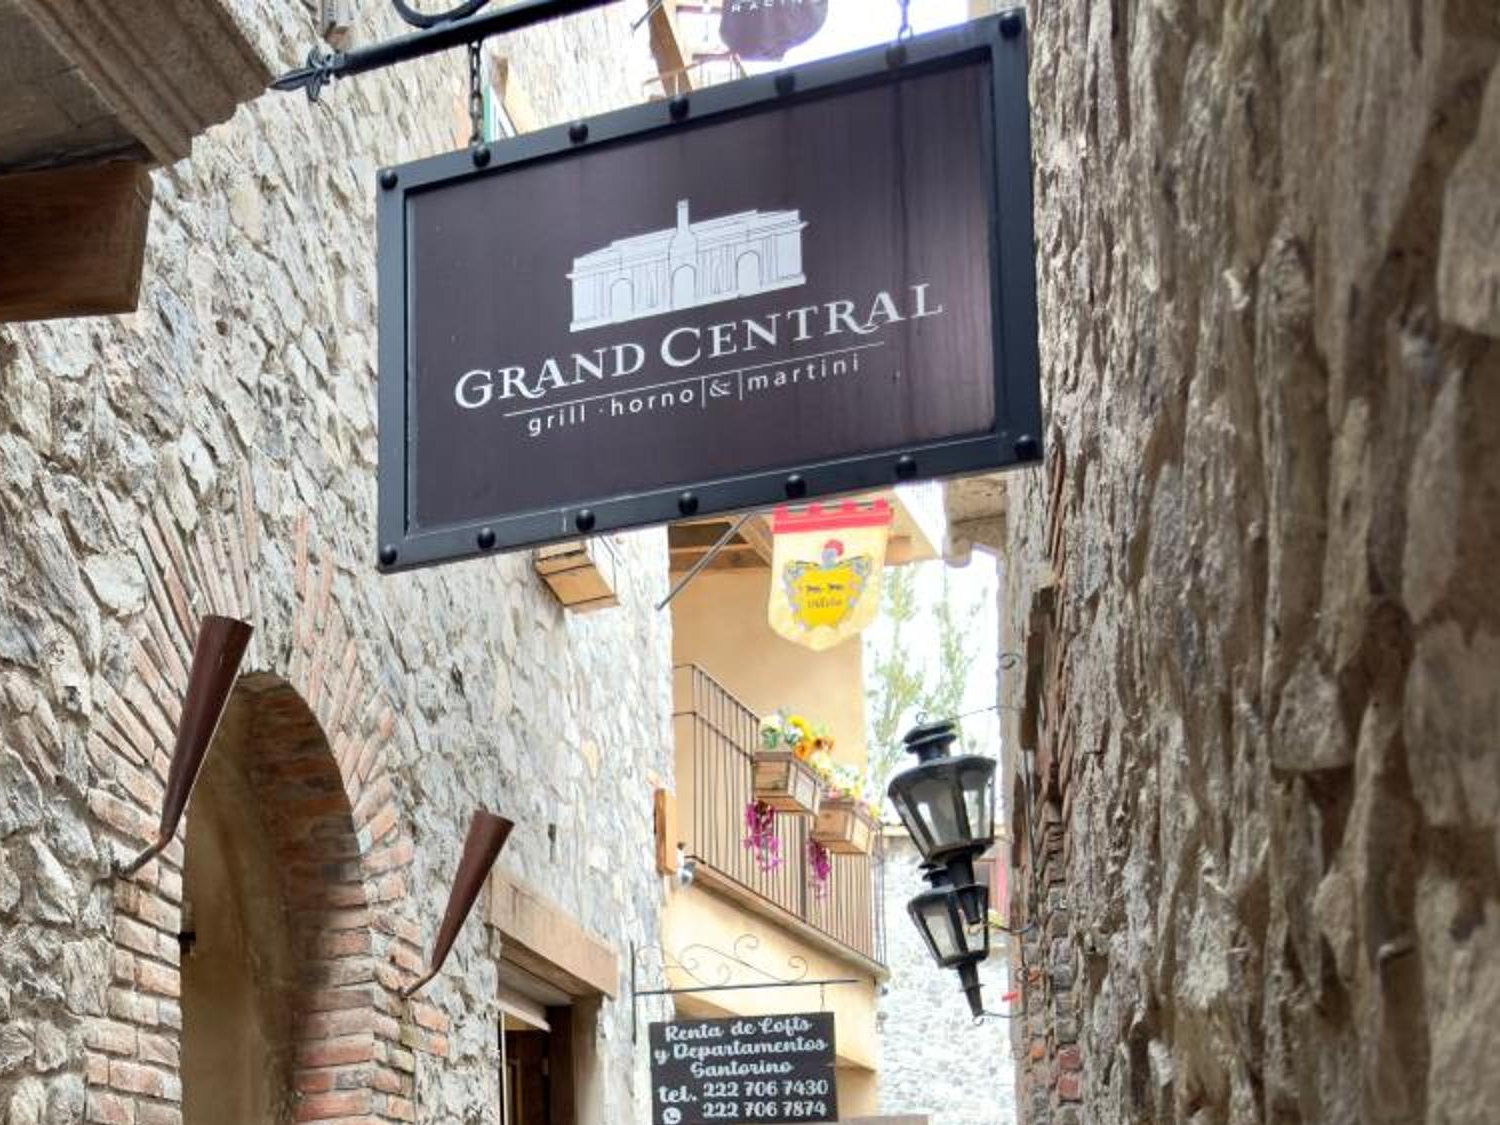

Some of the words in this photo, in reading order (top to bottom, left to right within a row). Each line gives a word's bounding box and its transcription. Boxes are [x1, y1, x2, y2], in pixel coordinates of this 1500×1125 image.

[455, 343, 645, 409] GRAND
[660, 283, 943, 367] CENTRAL
[528, 404, 585, 437] grill
[611, 388, 694, 416] horno
[749, 352, 859, 391] martini
[665, 1025, 724, 1041] Renta
[730, 1020, 756, 1036] de
[758, 1016, 812, 1036] Lofts
[654, 1049, 670, 1065] y
[673, 1036, 828, 1060] Departamentos
[690, 1060, 794, 1078] Santorino
[703, 1081, 739, 1097] 222
[743, 1080, 778, 1097] 706
[782, 1079, 828, 1096] 7430
[703, 1102, 739, 1117] 222
[743, 1101, 778, 1117] 706
[782, 1100, 828, 1117] 7874
